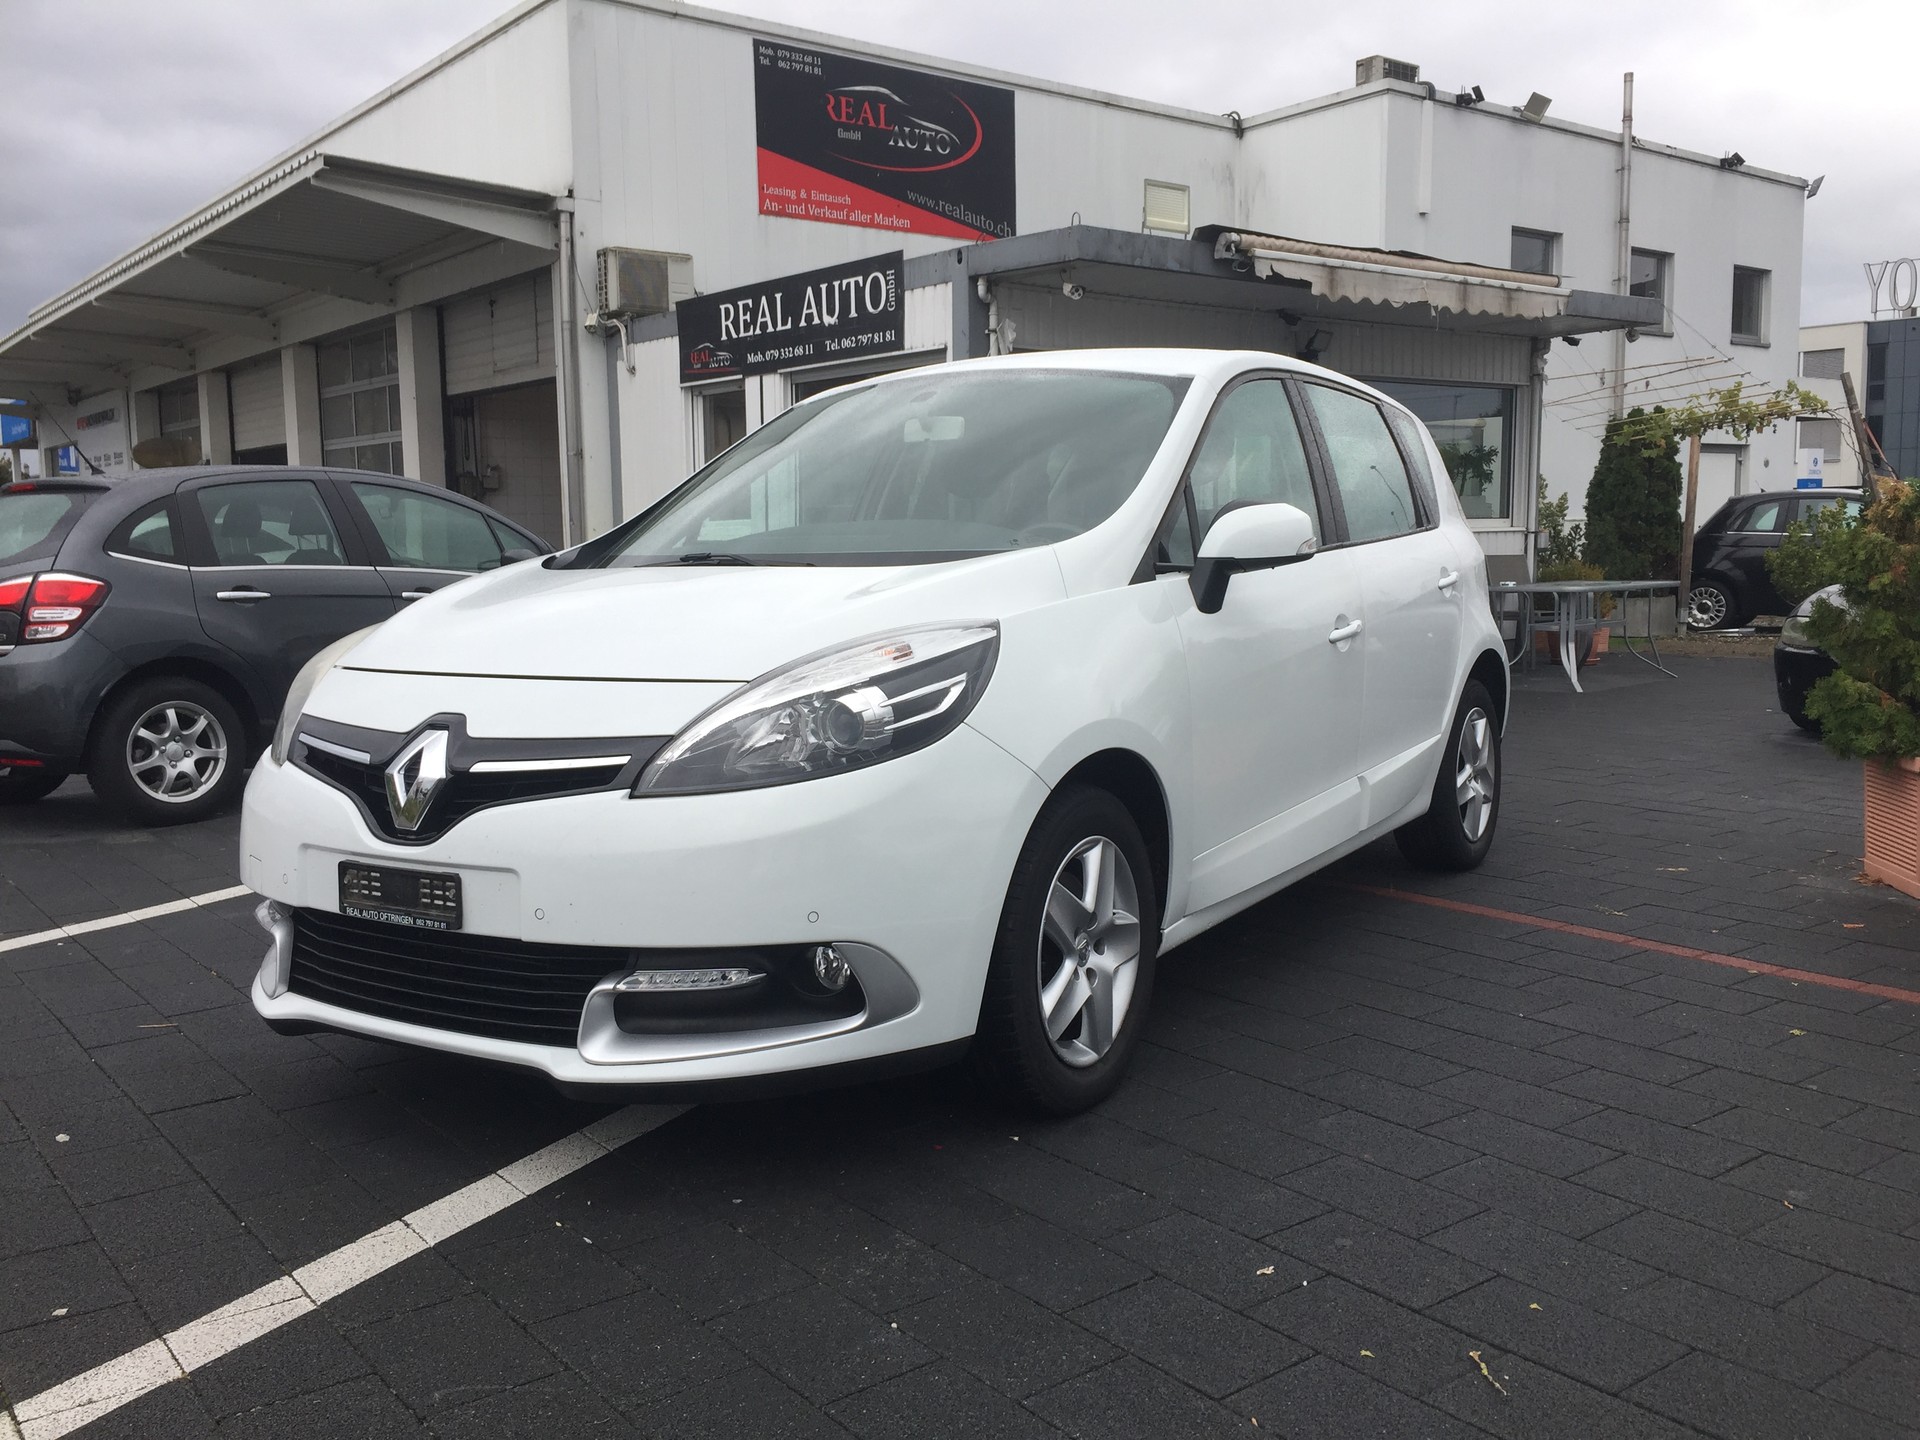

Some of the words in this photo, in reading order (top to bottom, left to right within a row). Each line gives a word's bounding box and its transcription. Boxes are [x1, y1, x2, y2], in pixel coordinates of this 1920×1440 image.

[759, 45, 775, 56] Mob.
[777, 49, 790, 58] 079
[791, 52, 803, 61] 332
[804, 55, 812, 63] 68
[814, 56, 821, 65] 11
[759, 56, 771, 65] Tel.
[777, 60, 790, 70] 062
[791, 62, 804, 71] 797
[804, 65, 812, 74] 81
[814, 67, 822, 75] 81
[825, 93, 895, 130] REAL
[837, 127, 862, 141] GmbH
[888, 125, 951, 155] AUTO
[763, 183, 797, 199] Leasing
[800, 189, 807, 199] &
[811, 190, 851, 205] Eintausch
[763, 198, 782, 212] An-
[785, 203, 806, 215] und
[807, 204, 848, 220] Verkauf
[849, 209, 872, 224] aller
[874, 212, 911, 228] Marken
[906, 189, 1013, 238] www.realauto.ch
[886, 269, 896, 312] GmbH
[1863, 257, 1918, 314] YO
[719, 292, 792, 341] REAL
[799, 271, 887, 327] AUTO
[825, 339, 841, 352] Tel.
[841, 336, 856, 349] 062
[857, 333, 873, 346] 797
[873, 331, 884, 344] 81
[885, 329, 896, 341] 81
[709, 355, 731, 368] AUTO
[747, 351, 765, 364] Mob.
[765, 348, 779, 361] 079
[780, 347, 794, 359] 332
[794, 345, 804, 357] 68
[805, 343, 814, 355] 11
[346, 906, 361, 917] REAL
[362, 909, 379, 920] AUTO
[380, 912, 414, 925] OFTRINGEN
